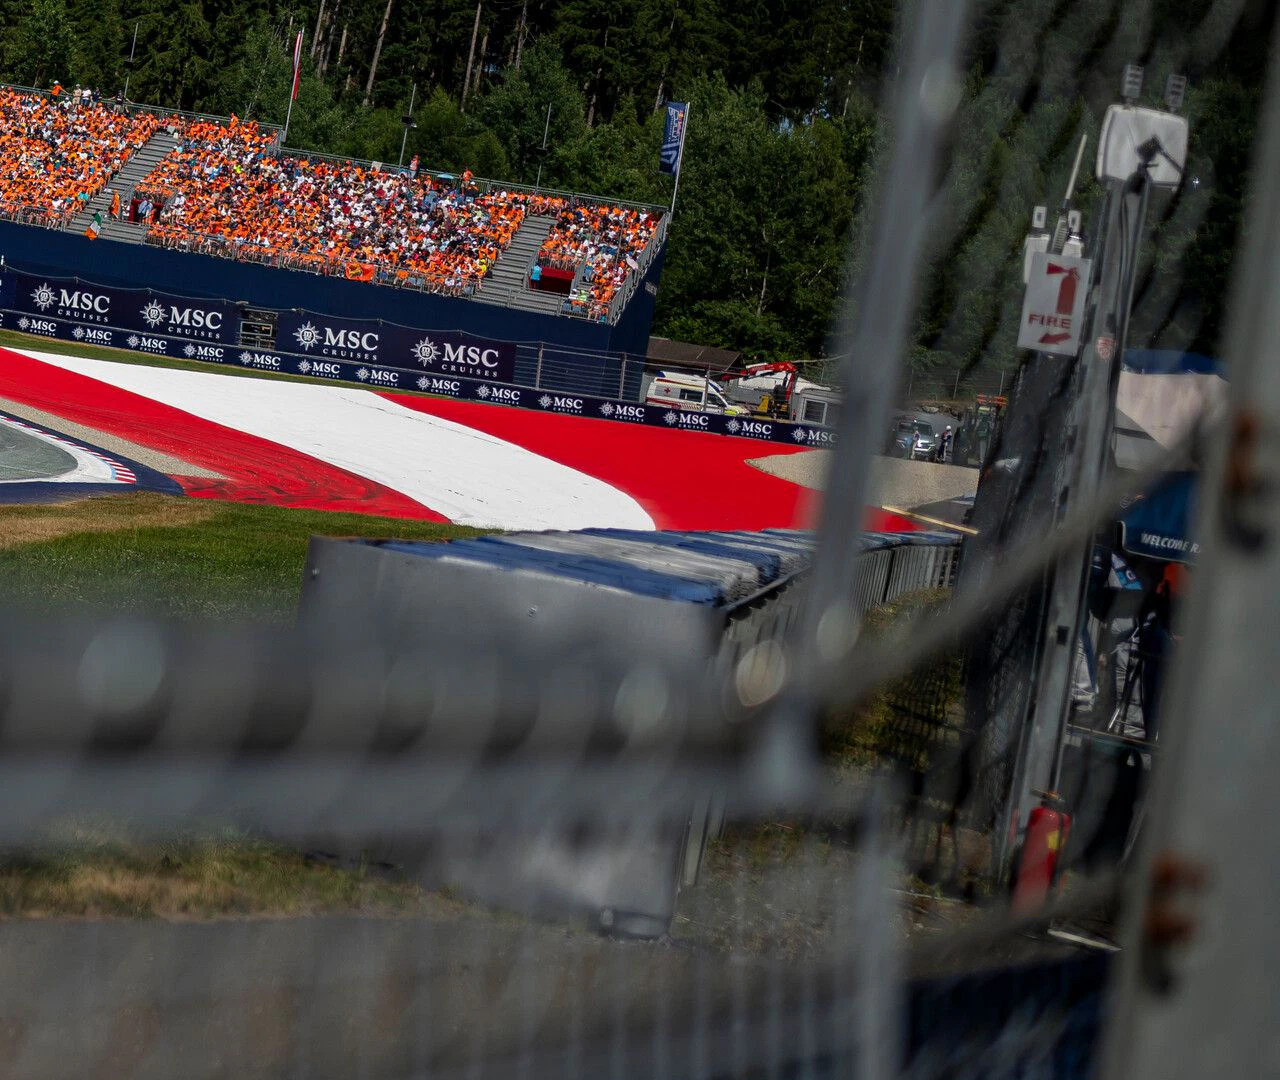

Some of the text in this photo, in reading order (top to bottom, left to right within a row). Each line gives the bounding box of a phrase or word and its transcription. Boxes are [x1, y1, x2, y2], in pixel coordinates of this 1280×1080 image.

[59, 289, 110, 314] MSC
[58, 309, 108, 322] CRUISES
[169, 306, 222, 329] MSC
[1028, 314, 1071, 328] FIRE
[30, 320, 56, 332] MSC
[86, 329, 112, 340] MSC
[168, 326, 220, 339] CRUISES
[140, 337, 166, 349] MSC
[324, 328, 378, 351] MSC
[198, 346, 223, 357] MSC
[323, 348, 377, 360] CRUISES
[443, 343, 498, 368] MSC
[254, 354, 280, 366] MSC
[311, 362, 340, 373] MSC
[442, 364, 497, 377] CRUISES
[371, 370, 398, 382] MSC
[432, 379, 460, 391] MSC
[490, 387, 520, 400] MSC
[554, 397, 582, 409] MSC
[614, 405, 644, 417] MSC
[680, 413, 708, 425] MSC
[742, 422, 771, 434] MSC
[1142, 533, 1188, 552] WELCOME
